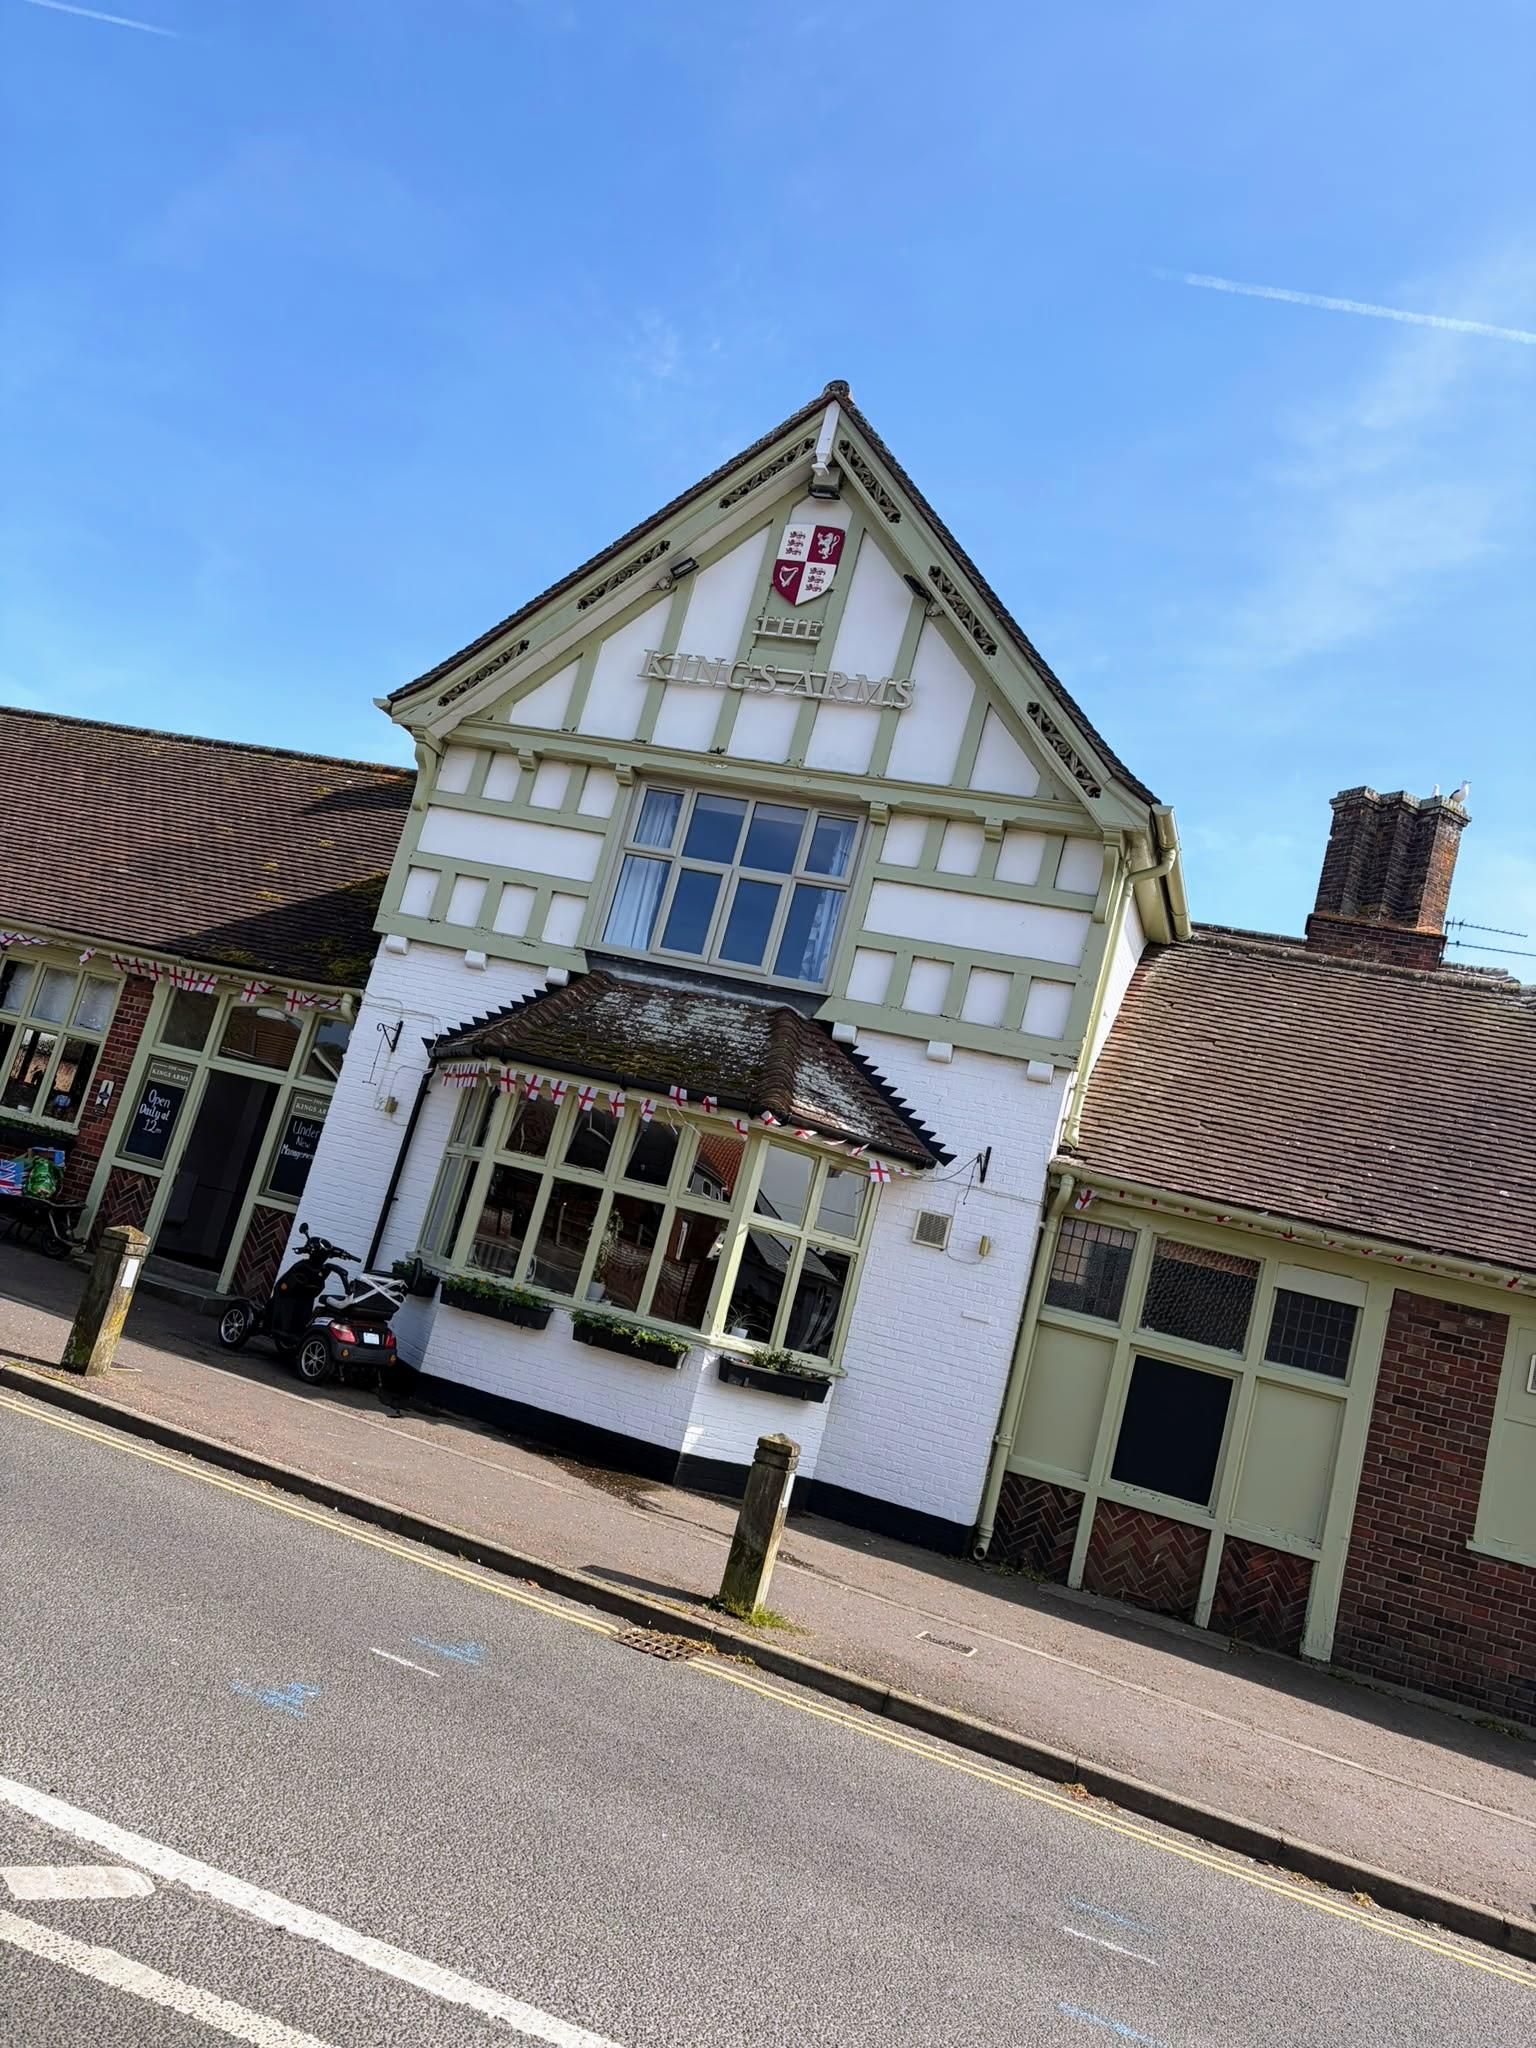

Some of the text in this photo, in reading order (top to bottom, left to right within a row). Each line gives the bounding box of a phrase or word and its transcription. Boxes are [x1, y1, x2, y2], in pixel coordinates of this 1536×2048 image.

[755, 615, 824, 641] THE
[637, 648, 916, 710] KINGS ARMS
[151, 1068, 189, 1082] KINGS ARMS
[148, 1089, 171, 1109] Open
[295, 1102, 317, 1112] KINGS
[139, 1103, 171, 1121] Daily at
[292, 1120, 320, 1138] Under
[280, 1143, 316, 1160] Managemen
[295, 1136, 311, 1149] New
